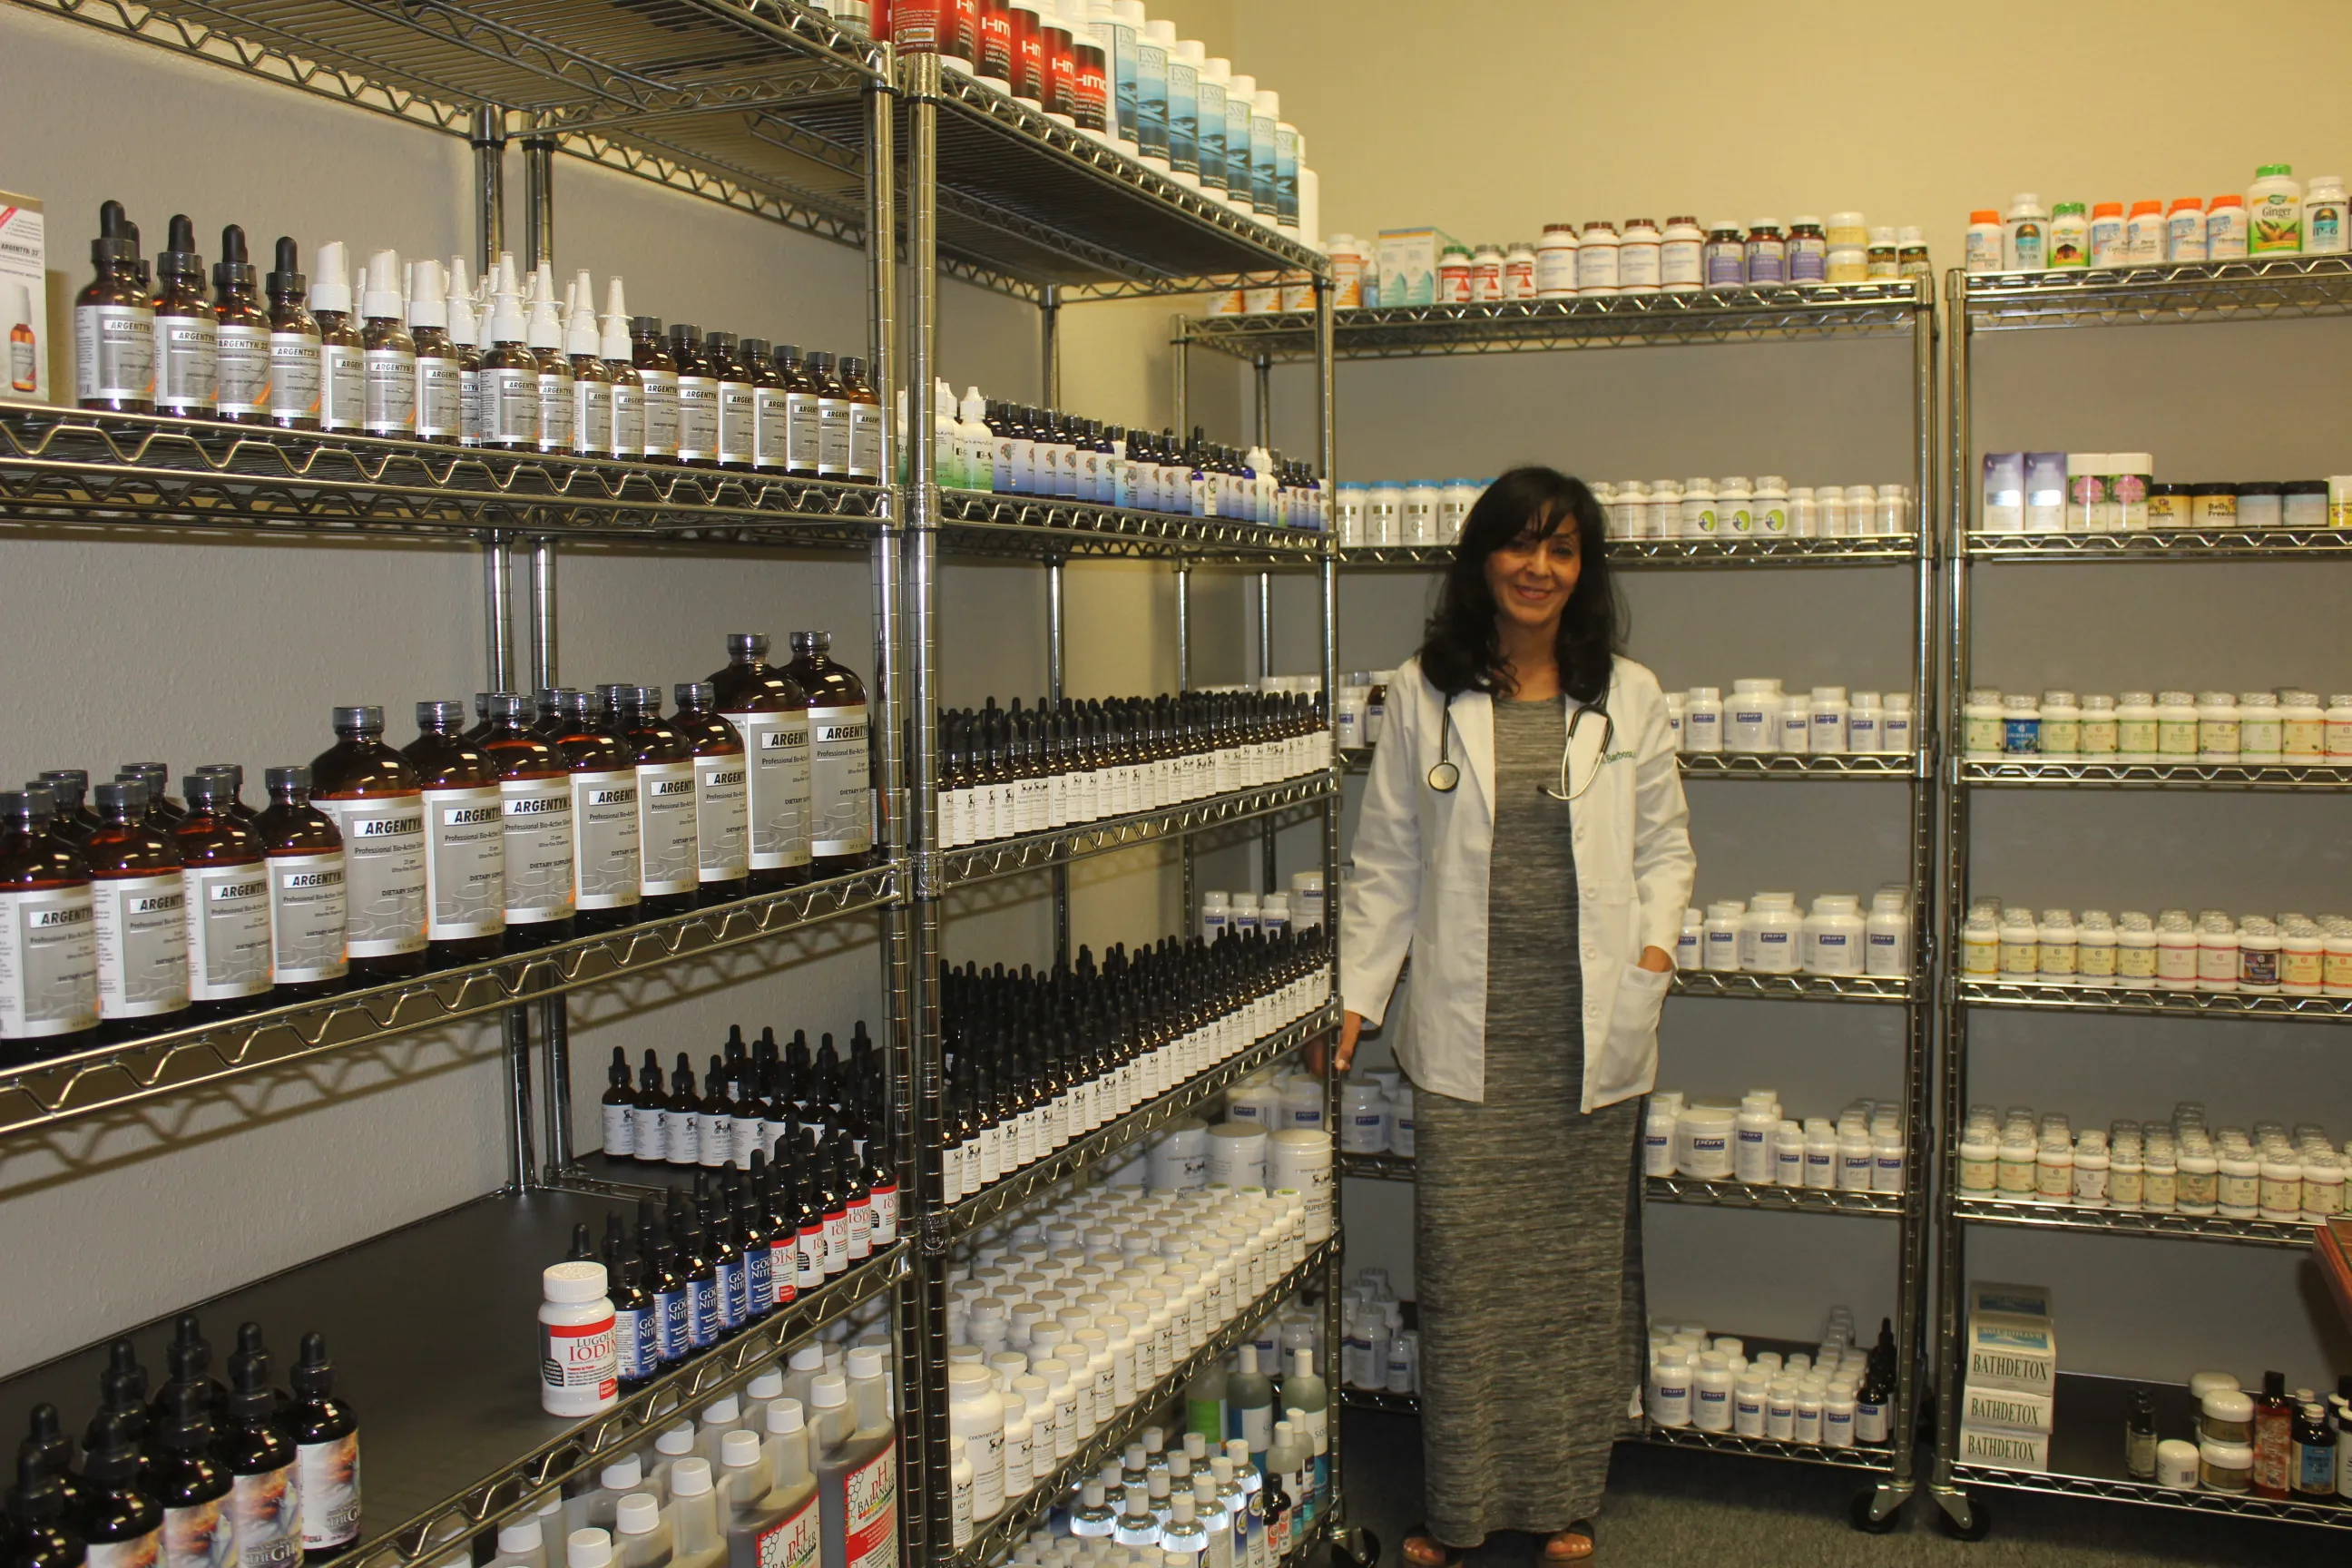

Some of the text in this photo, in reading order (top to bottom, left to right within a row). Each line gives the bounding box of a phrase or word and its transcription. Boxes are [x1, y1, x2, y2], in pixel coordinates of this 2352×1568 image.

[2261, 207, 2292, 220] Ginger
[1, 241, 31, 257] ARGENTYN
[218, 338, 260, 349] ARGENTYN
[817, 749, 848, 758] Professional
[761, 755, 793, 765] Professional
[706, 792, 732, 800] Professional
[839, 787, 859, 796] DIETARY
[513, 797, 568, 813] ARGENTYN
[652, 801, 680, 810] Professional
[785, 797, 803, 805] DIETARY
[589, 811, 620, 821] Professional
[365, 817, 422, 837] ARGENTYN
[505, 820, 562, 831] Professional Bio-Active
[726, 825, 741, 833] DIETARY
[445, 832, 478, 842] Professional
[355, 842, 417, 856] Professional Bio-Active
[611, 849, 630, 858] DIETARY
[529, 861, 553, 869] DIETARY
[292, 872, 342, 887] ARGENTYN
[469, 873, 490, 882] DIETARY
[382, 888, 406, 897] DIETARY
[283, 895, 315, 904] Professional
[1695, 1139, 1724, 1147] pure
[1973, 1353, 2047, 1382] BATHDETOX
[1971, 1397, 2039, 1426] BATHDETOX
[968, 1431, 993, 1442] COUNTRY
[1967, 1435, 2035, 1463] BATHDETOX
